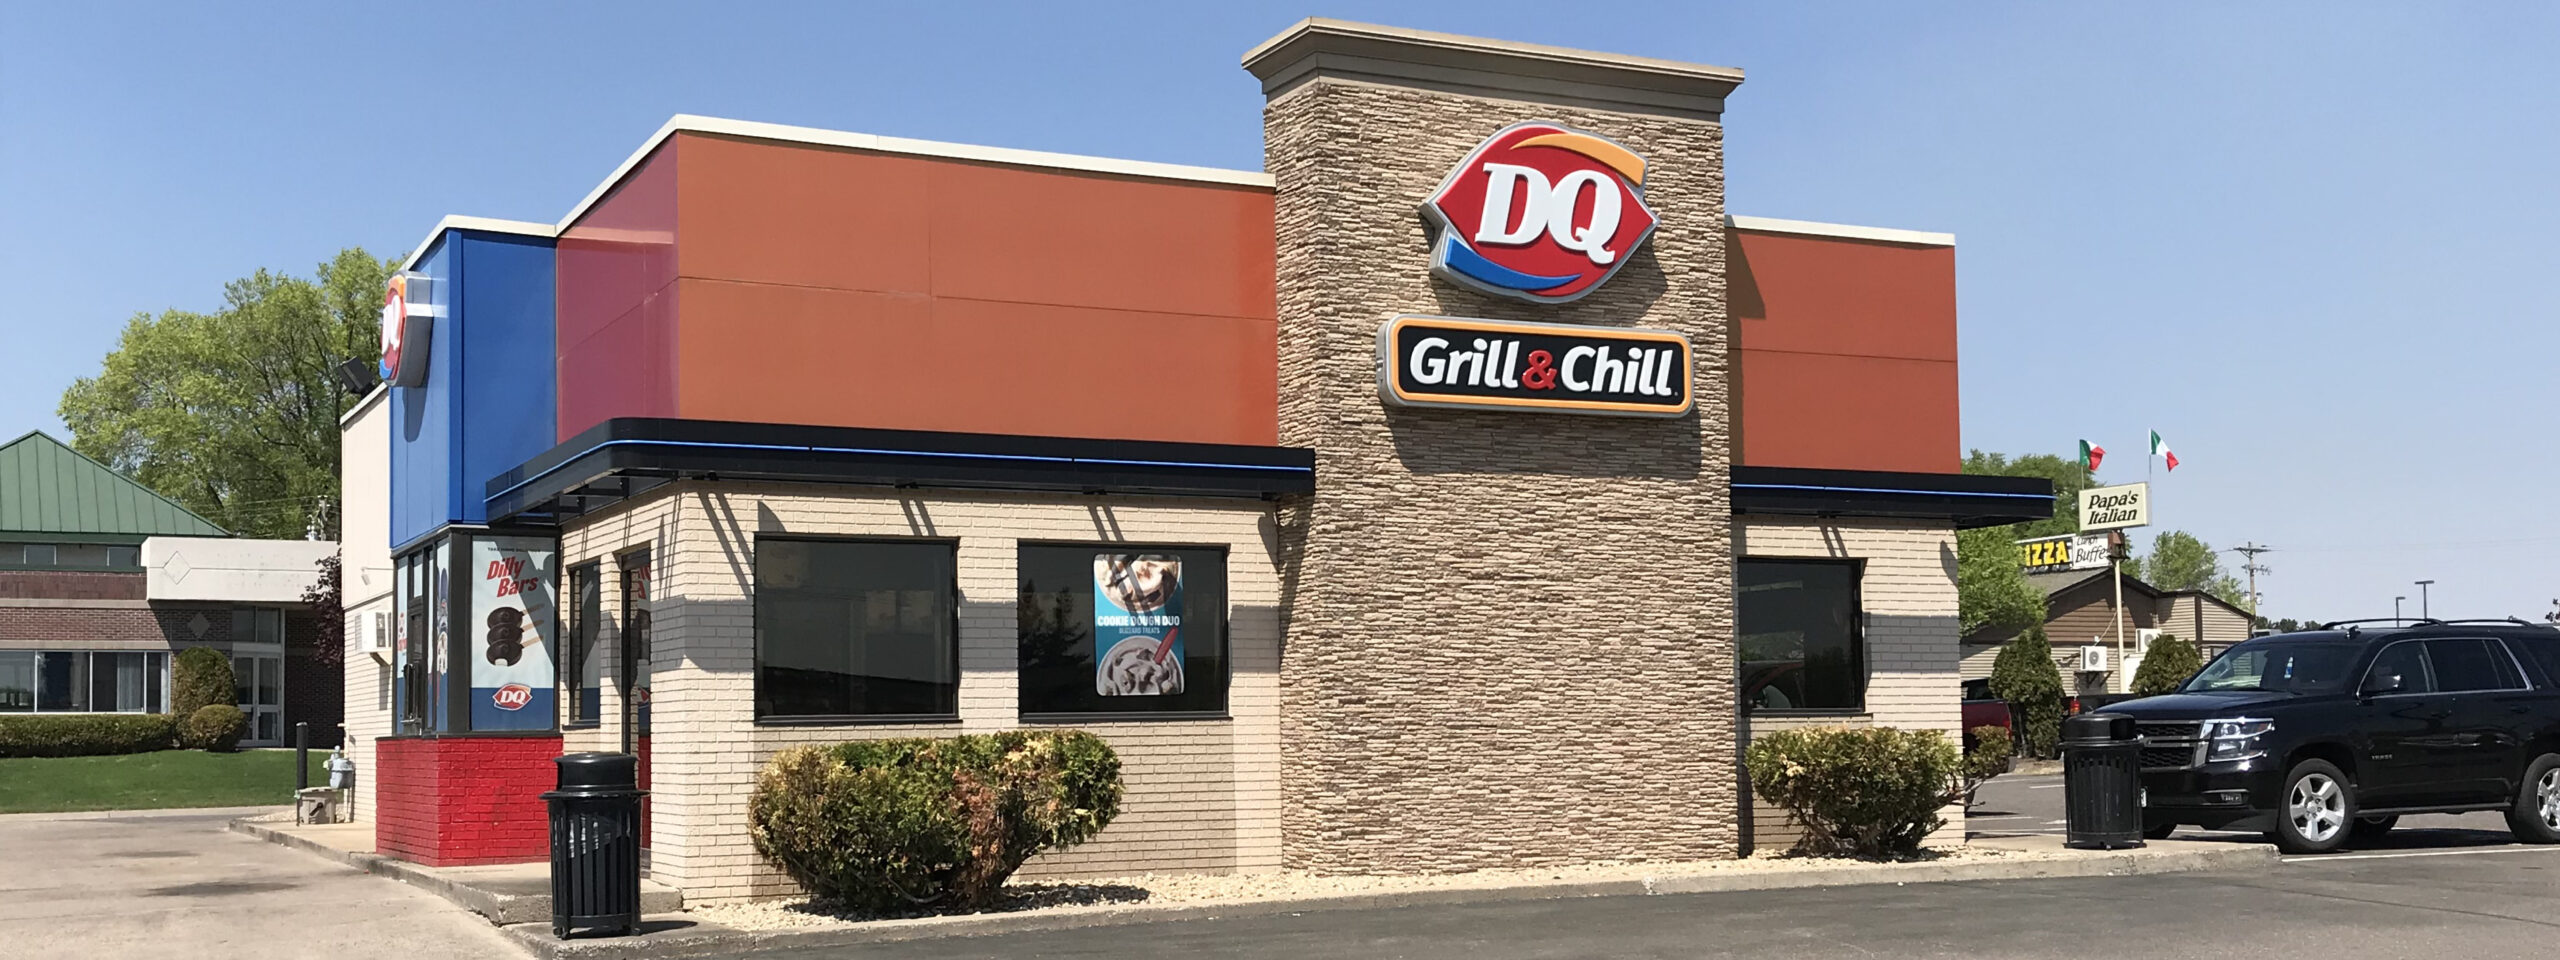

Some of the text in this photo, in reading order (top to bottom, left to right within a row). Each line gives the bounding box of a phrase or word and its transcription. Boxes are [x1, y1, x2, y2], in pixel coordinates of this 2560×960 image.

[1475, 162, 1622, 264] DQ
[2088, 490, 2139, 511] Papa's
[2088, 508, 2138, 526] Italian
[2025, 541, 2070, 567] IZZA
[2076, 545, 2107, 563] Buffe
[486, 555, 526, 580] Dilly
[497, 577, 539, 598] Bars
[1097, 615, 1180, 627] COOKIE DOUGH DUO
[500, 690, 526, 705] DQ
